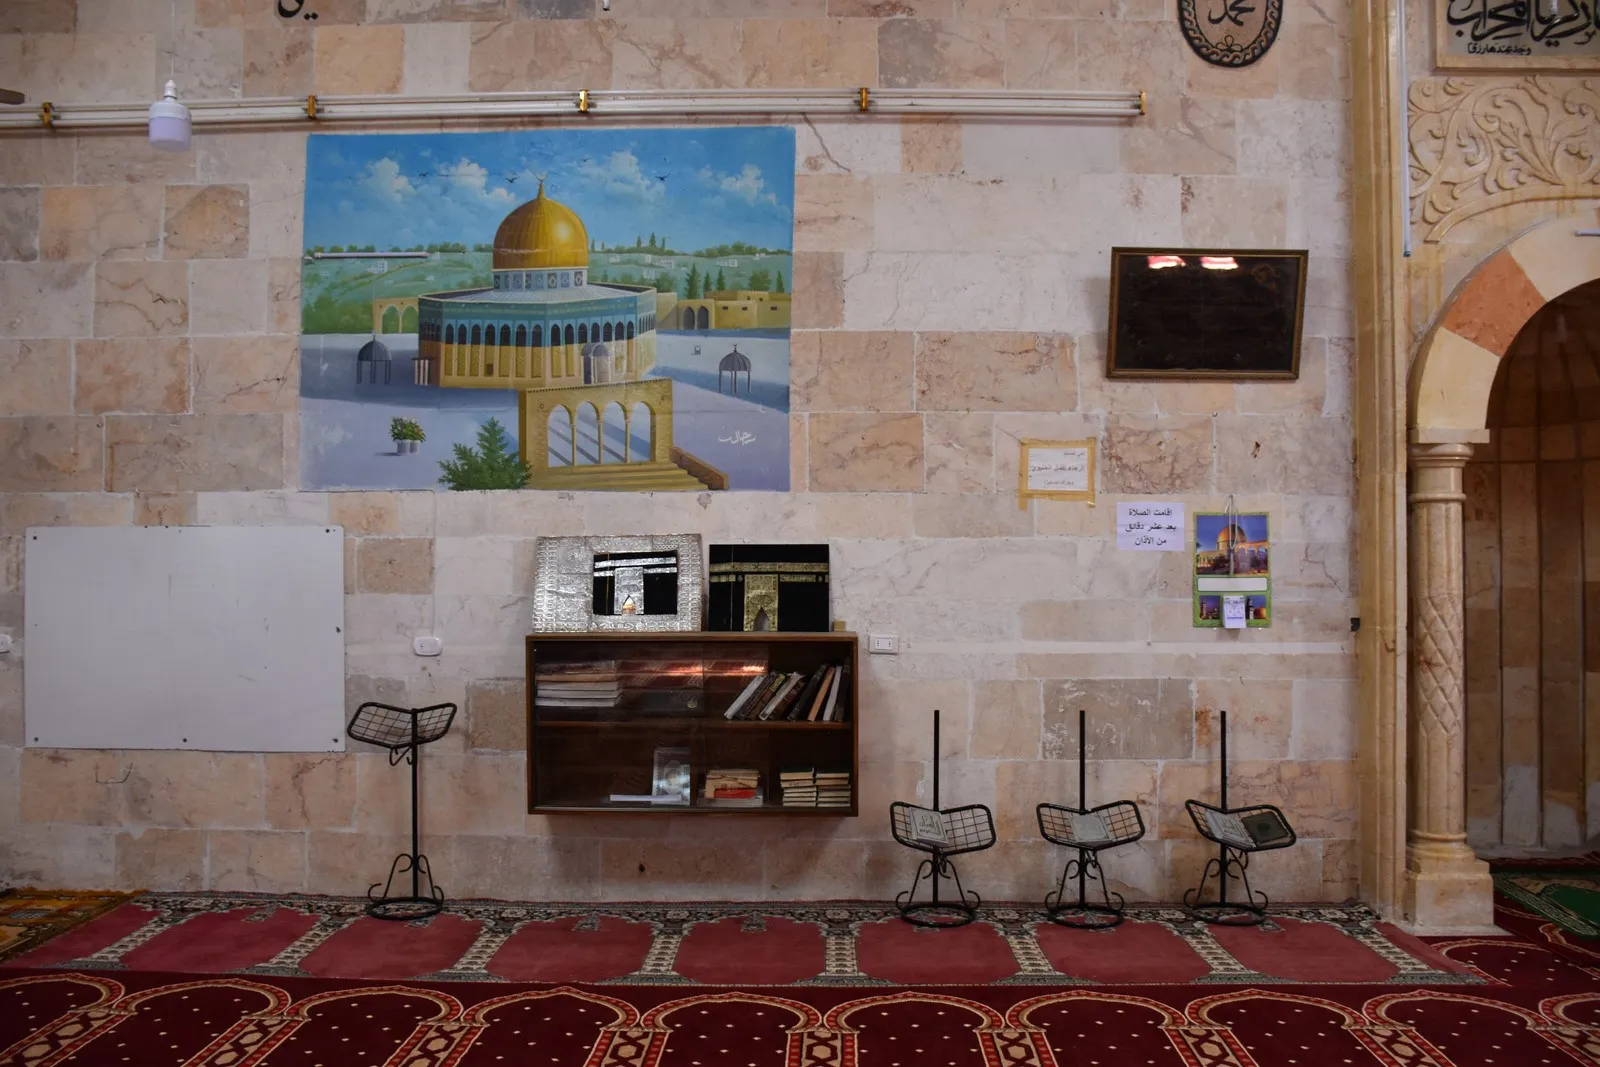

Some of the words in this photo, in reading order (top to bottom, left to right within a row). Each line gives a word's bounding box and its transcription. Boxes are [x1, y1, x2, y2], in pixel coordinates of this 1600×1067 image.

[1128, 508, 1151, 516] الصلاة
[1125, 521, 1145, 532] دقائق
[1148, 522, 1163, 532] عشر
[1166, 524, 1177, 532] بعد
[1156, 538, 1167, 546] من
